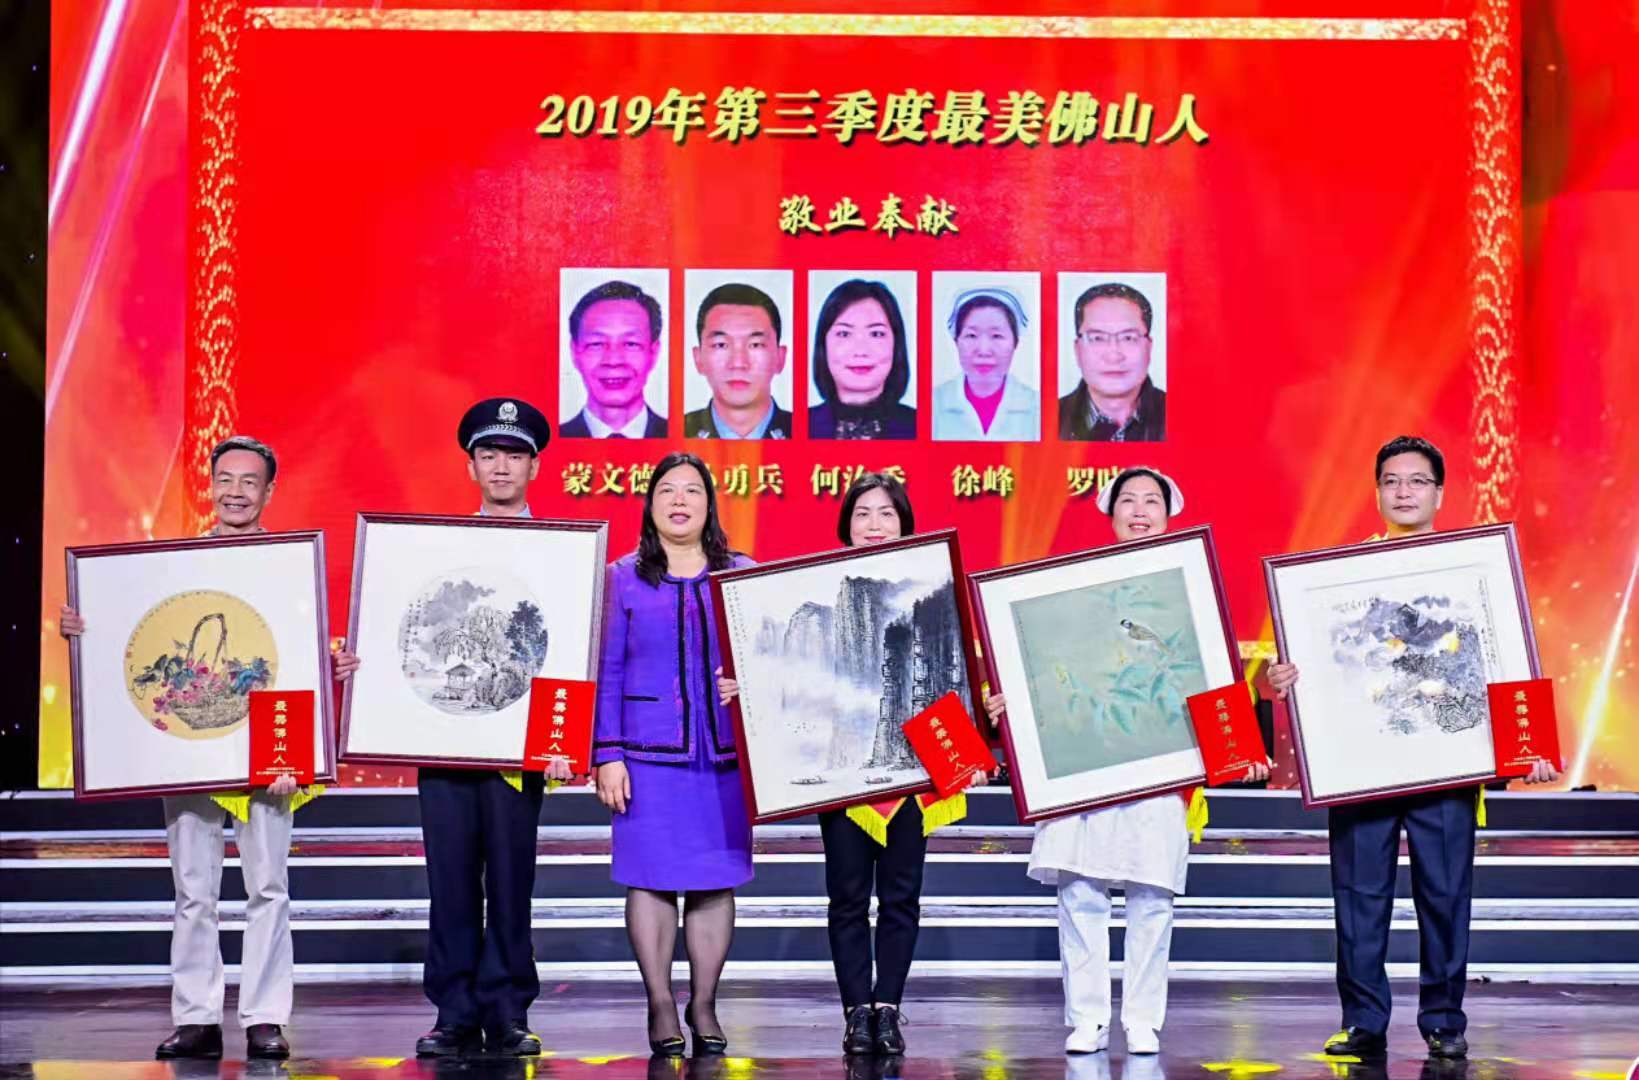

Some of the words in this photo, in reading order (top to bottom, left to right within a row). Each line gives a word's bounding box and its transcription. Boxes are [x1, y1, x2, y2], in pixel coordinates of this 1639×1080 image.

[535, 86, 1209, 144] 2019年第三季度最美佛山人
[779, 192, 960, 240] 敬业奉献
[952, 464, 1014, 497] 徐峰
